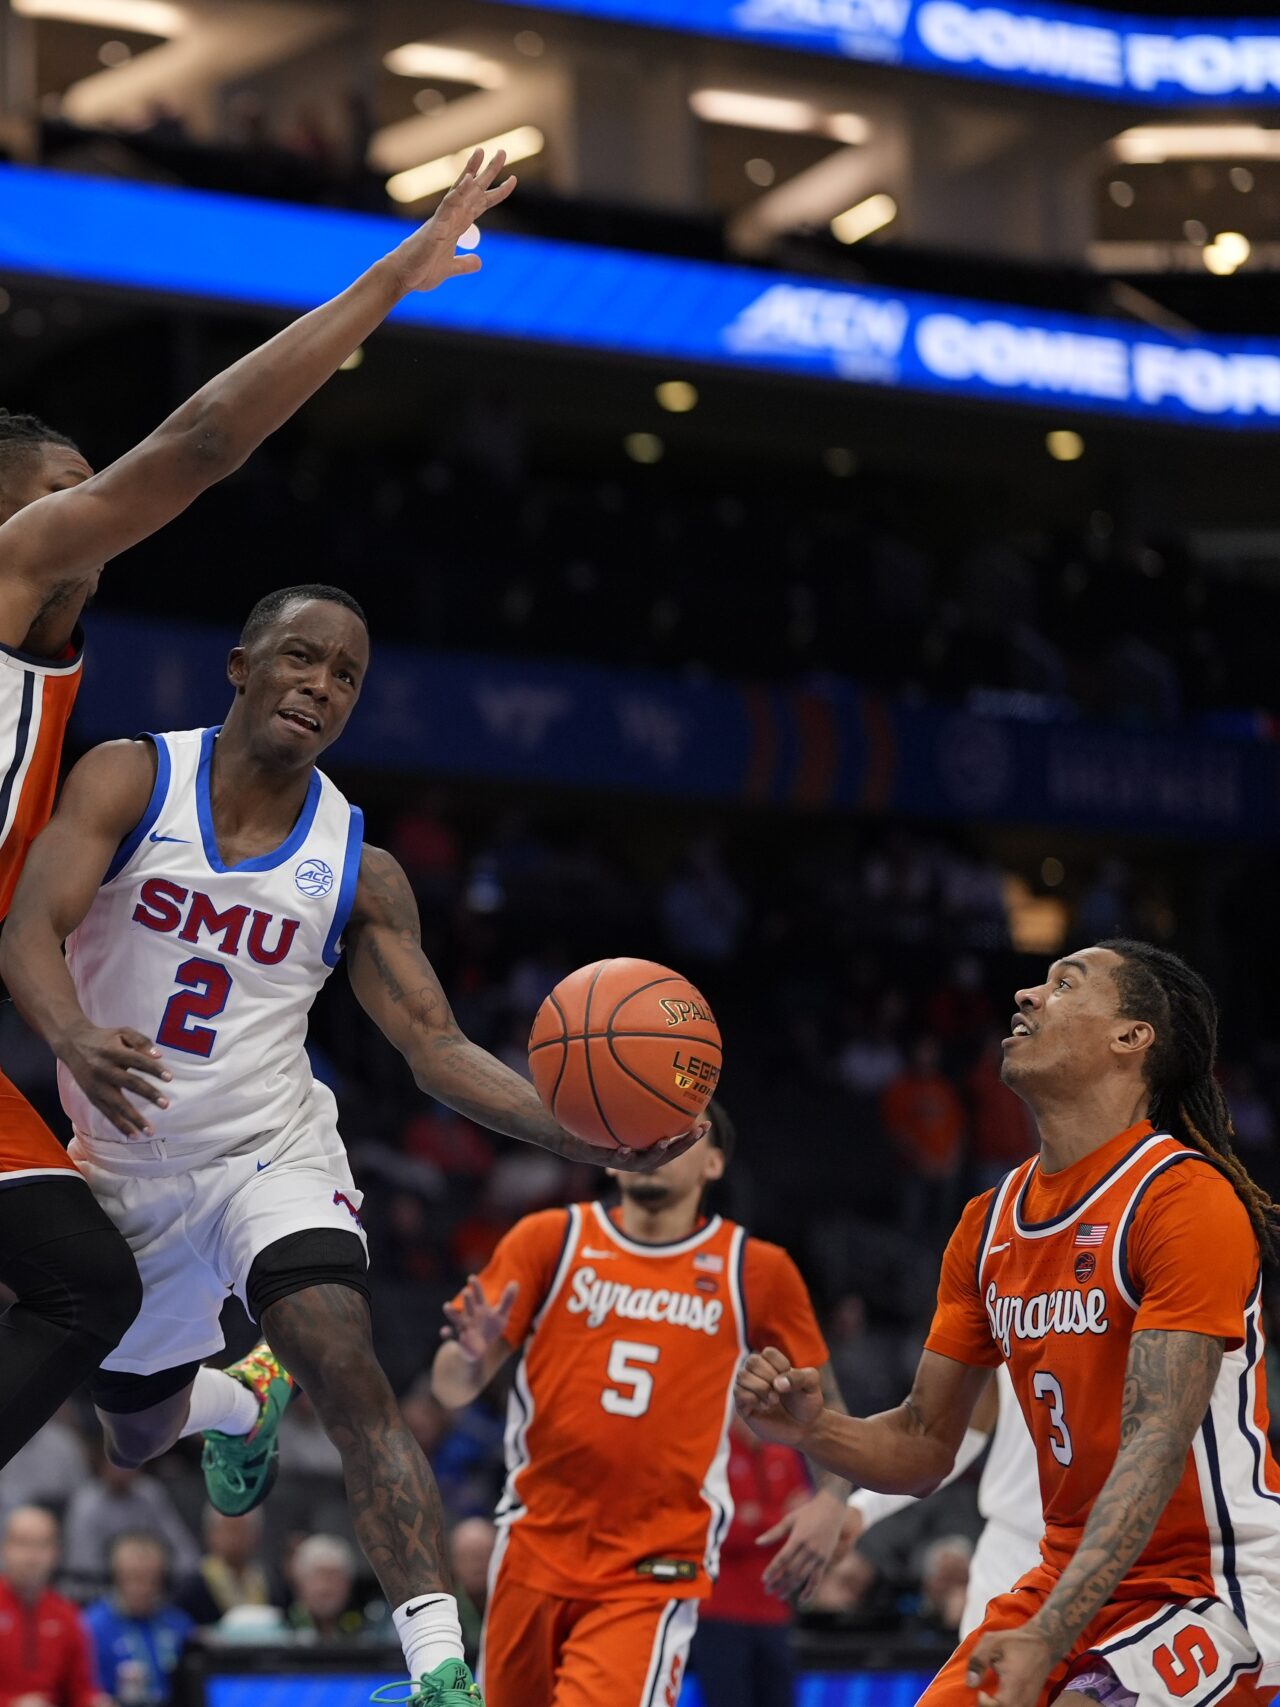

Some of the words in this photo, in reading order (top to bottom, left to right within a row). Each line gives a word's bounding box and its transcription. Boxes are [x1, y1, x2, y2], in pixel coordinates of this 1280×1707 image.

[917, 2, 1122, 88] COME
[916, 313, 1129, 400] COME
[297, 870, 333, 885] ACC
[132, 878, 300, 965] SMU
[156, 956, 233, 1058] 2
[567, 1266, 723, 1336] Syracuse
[985, 1281, 1109, 1359] Syracuse
[600, 1339, 660, 1418] 5
[1032, 1370, 1073, 1467] 3
[1152, 1624, 1219, 1697] S
